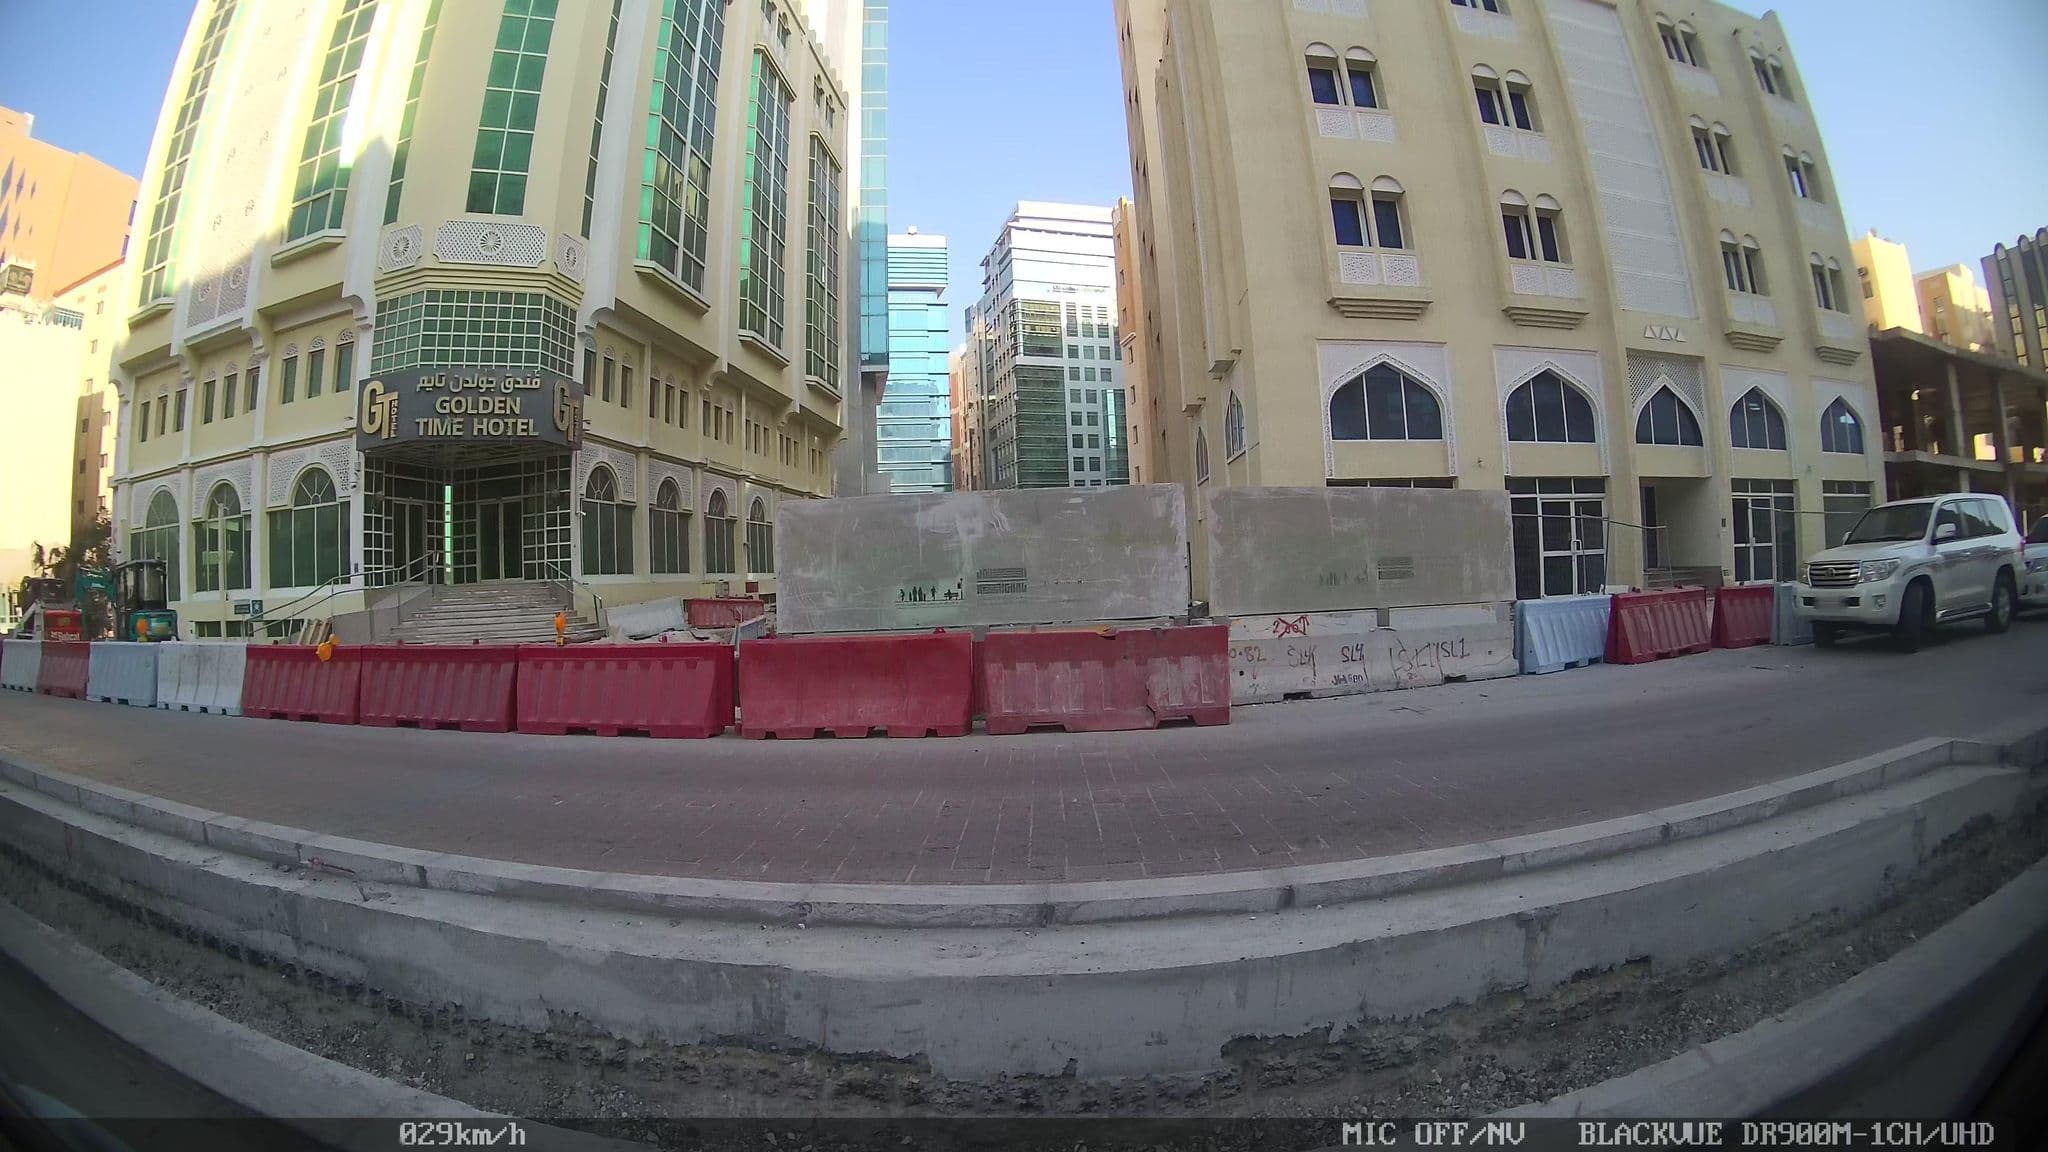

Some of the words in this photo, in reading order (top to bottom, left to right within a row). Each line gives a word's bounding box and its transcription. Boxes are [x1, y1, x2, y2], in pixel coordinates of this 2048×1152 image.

[416, 372, 446, 392] تايم
[449, 372, 497, 393] جولدن
[500, 370, 542, 394] فندق
[435, 396, 521, 415] GOLDEN
[415, 418, 464, 436] TIME
[472, 418, 540, 436] HOTEL
